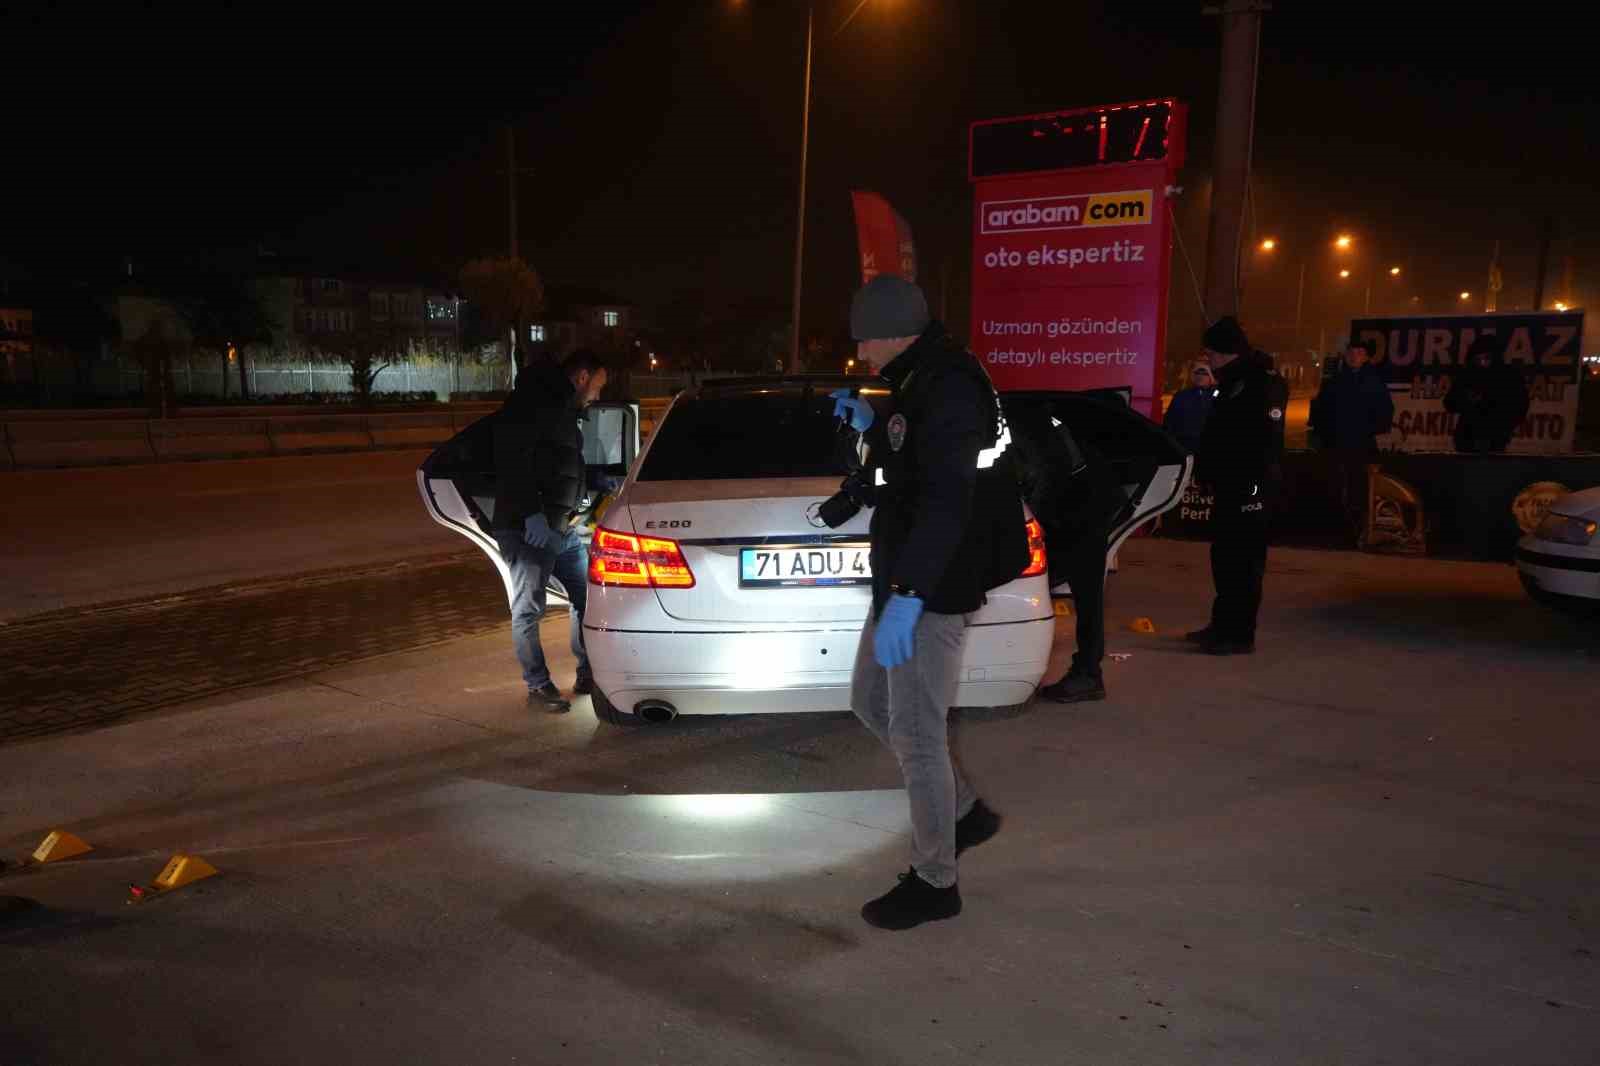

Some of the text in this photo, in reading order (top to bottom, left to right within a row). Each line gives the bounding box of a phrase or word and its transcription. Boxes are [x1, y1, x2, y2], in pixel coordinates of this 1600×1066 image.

[989, 200, 1144, 226] arabam com
[984, 239, 1145, 269] oto ekspertiz
[982, 317, 1142, 338] Uzman gözünden
[987, 347, 1137, 368] detaylı ekspertiz
[756, 551, 873, 577] 71 ADU 4
